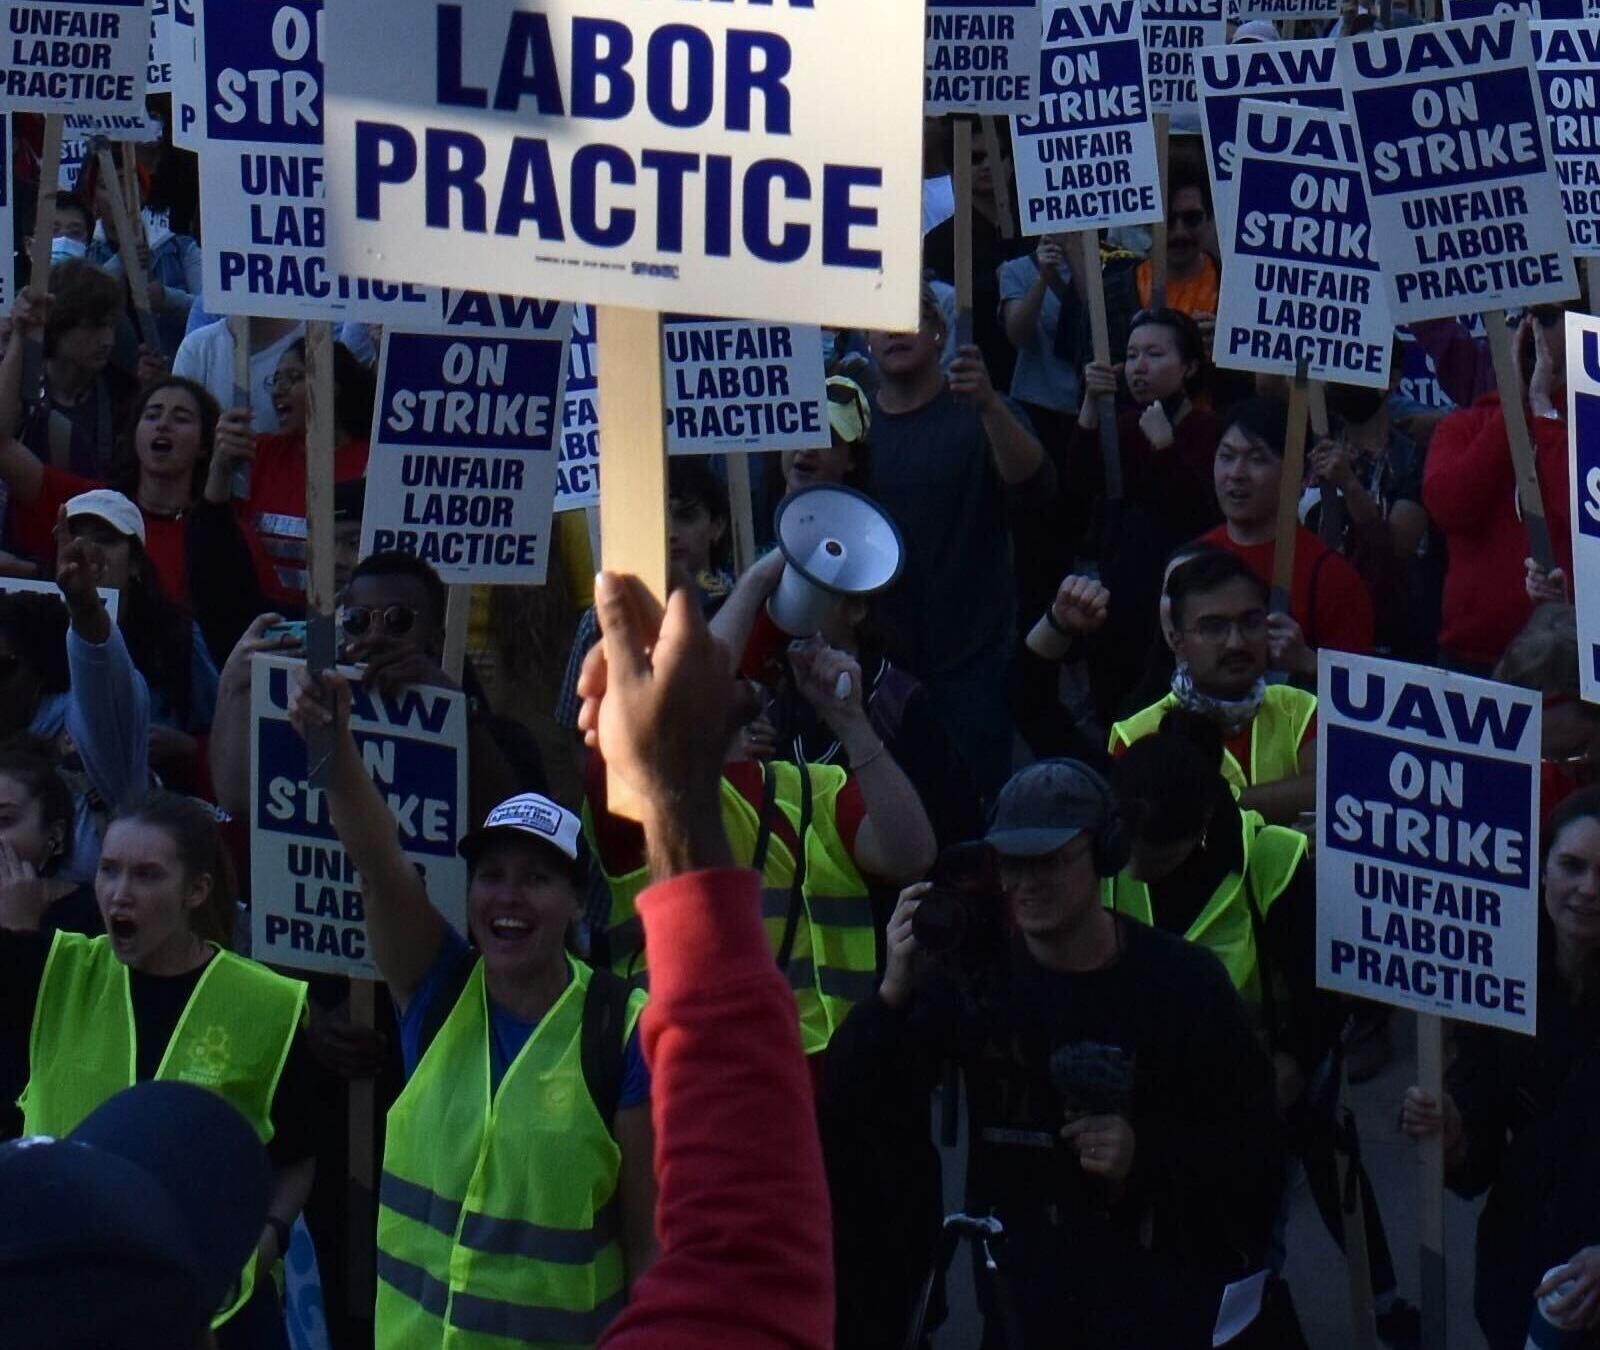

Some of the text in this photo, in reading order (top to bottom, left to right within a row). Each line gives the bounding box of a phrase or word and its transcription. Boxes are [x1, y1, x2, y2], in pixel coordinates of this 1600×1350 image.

[9, 6, 119, 38] UNFAIR
[12, 38, 111, 69] LABOR
[435, 3, 789, 132] LABOR
[355, 123, 880, 266] PRACTICE
[1329, 667, 1532, 752] UAW
[1388, 750, 1464, 809] ON
[1333, 795, 1524, 876] STRIKE
[1354, 861, 1500, 926] UNFAIR
[1361, 905, 1492, 967] LABOR
[1332, 940, 1525, 1015] PRACTICE
